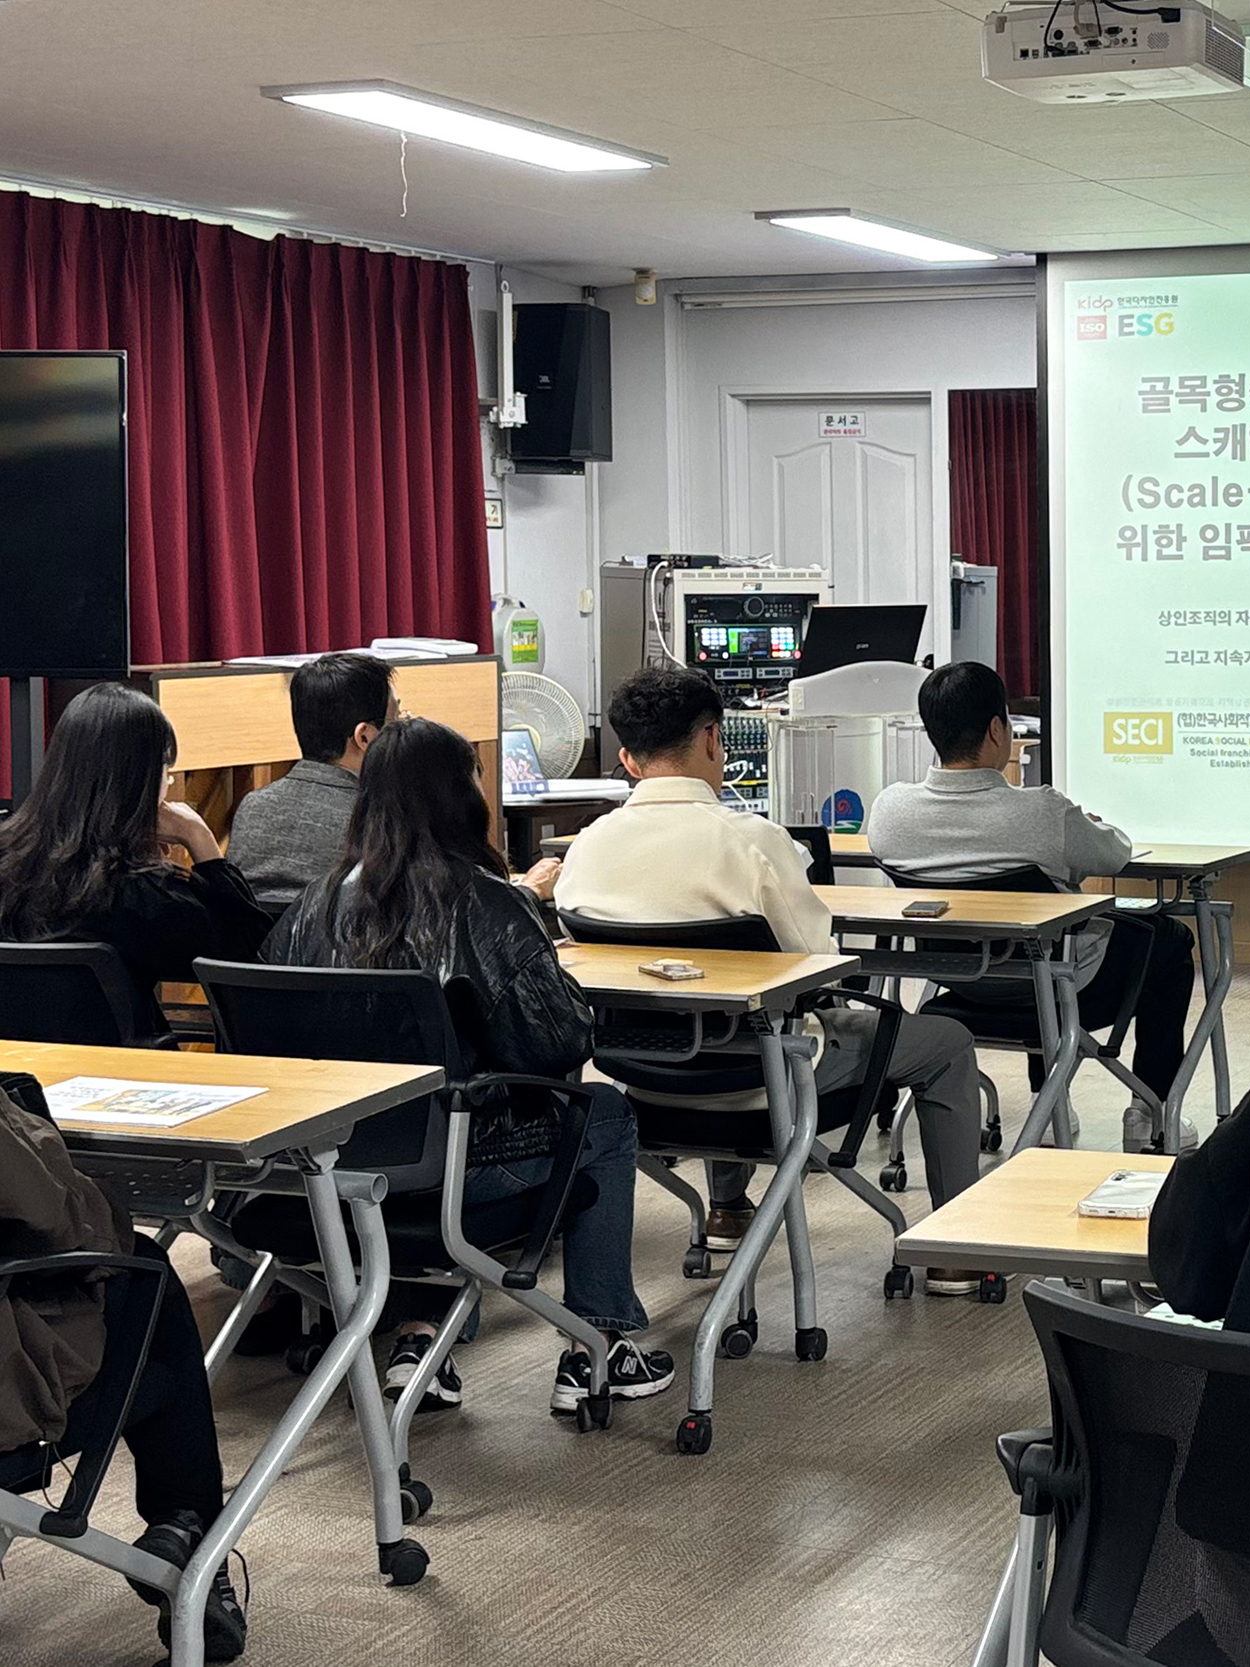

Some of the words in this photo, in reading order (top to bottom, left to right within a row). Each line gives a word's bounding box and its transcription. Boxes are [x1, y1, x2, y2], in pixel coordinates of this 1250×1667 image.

[1078, 295, 1114, 312] kidp
[1080, 322, 1105, 333] ISO
[1118, 312, 1175, 338] ESG
[1116, 523, 1187, 562] 위한
[1158, 609, 1232, 627] 상인조직의
[1164, 650, 1211, 666] 그리고
[1111, 718, 1164, 746] SECI
[1183, 736, 1213, 745] KOREA
[1215, 736, 1247, 746] SOCIAL
[1190, 748, 1218, 757] Social
